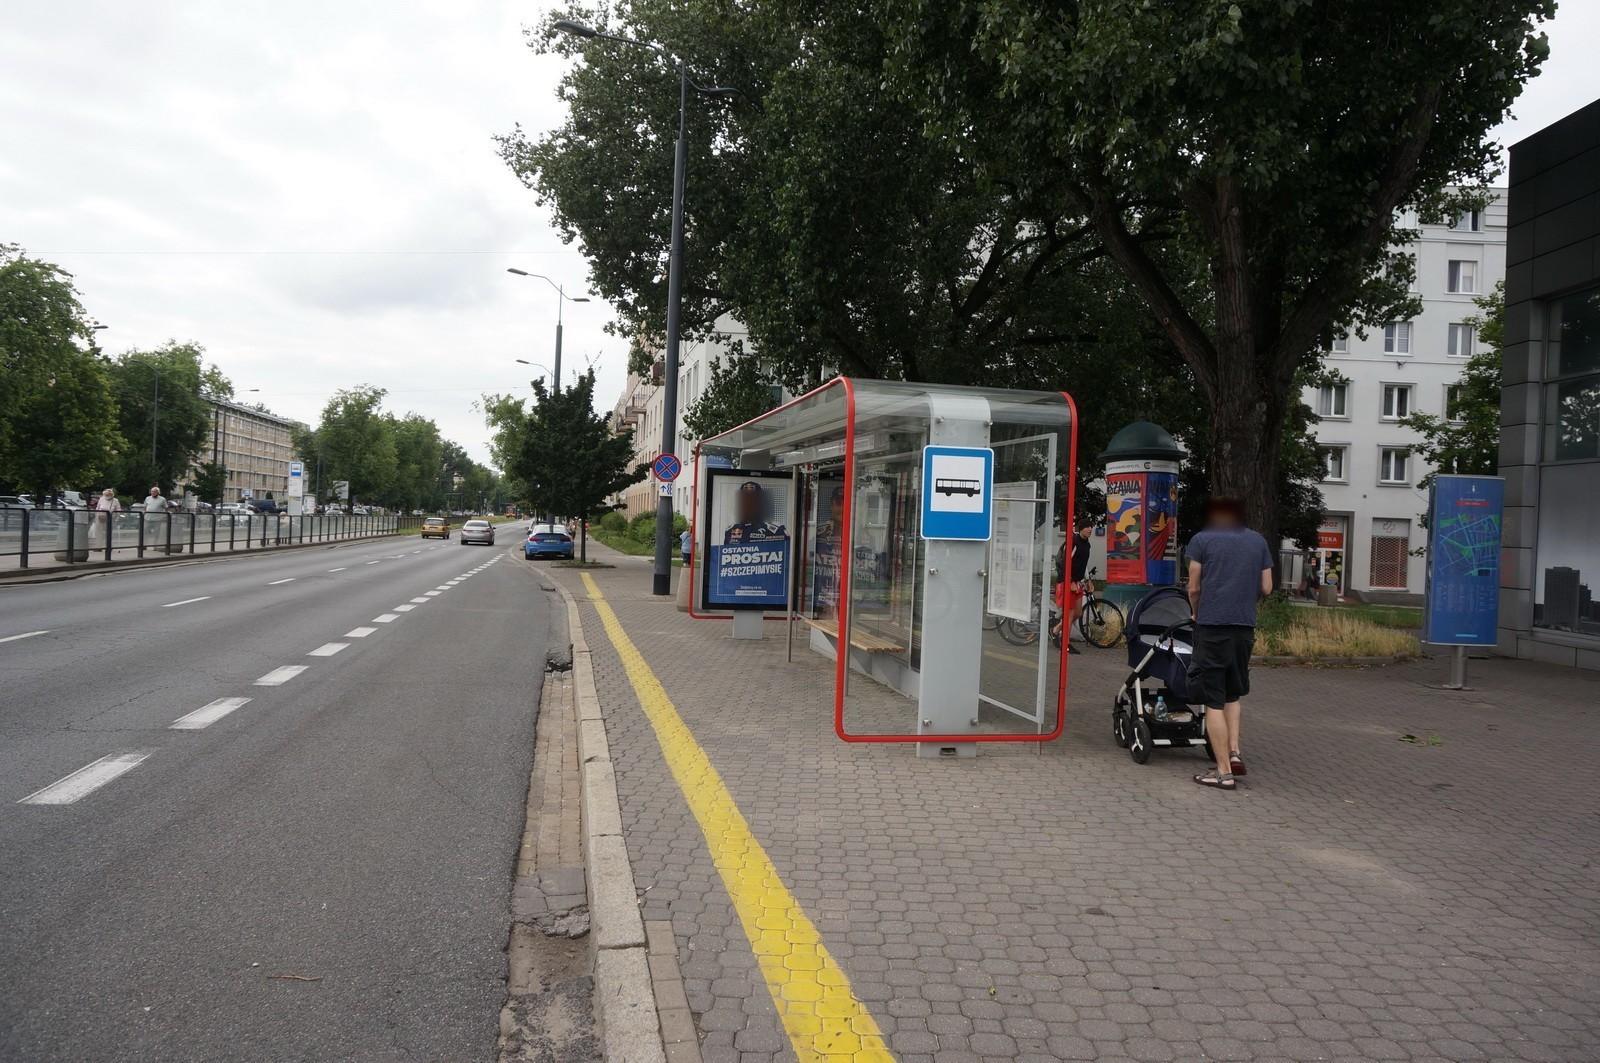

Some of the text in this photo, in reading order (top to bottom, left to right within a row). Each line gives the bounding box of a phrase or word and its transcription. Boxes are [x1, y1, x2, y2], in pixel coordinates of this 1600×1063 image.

[722, 546, 760, 555] OSTATNIA
[721, 551, 783, 566] PROSTA!
[720, 563, 783, 578] #SZCZEPIMYSIĘ
